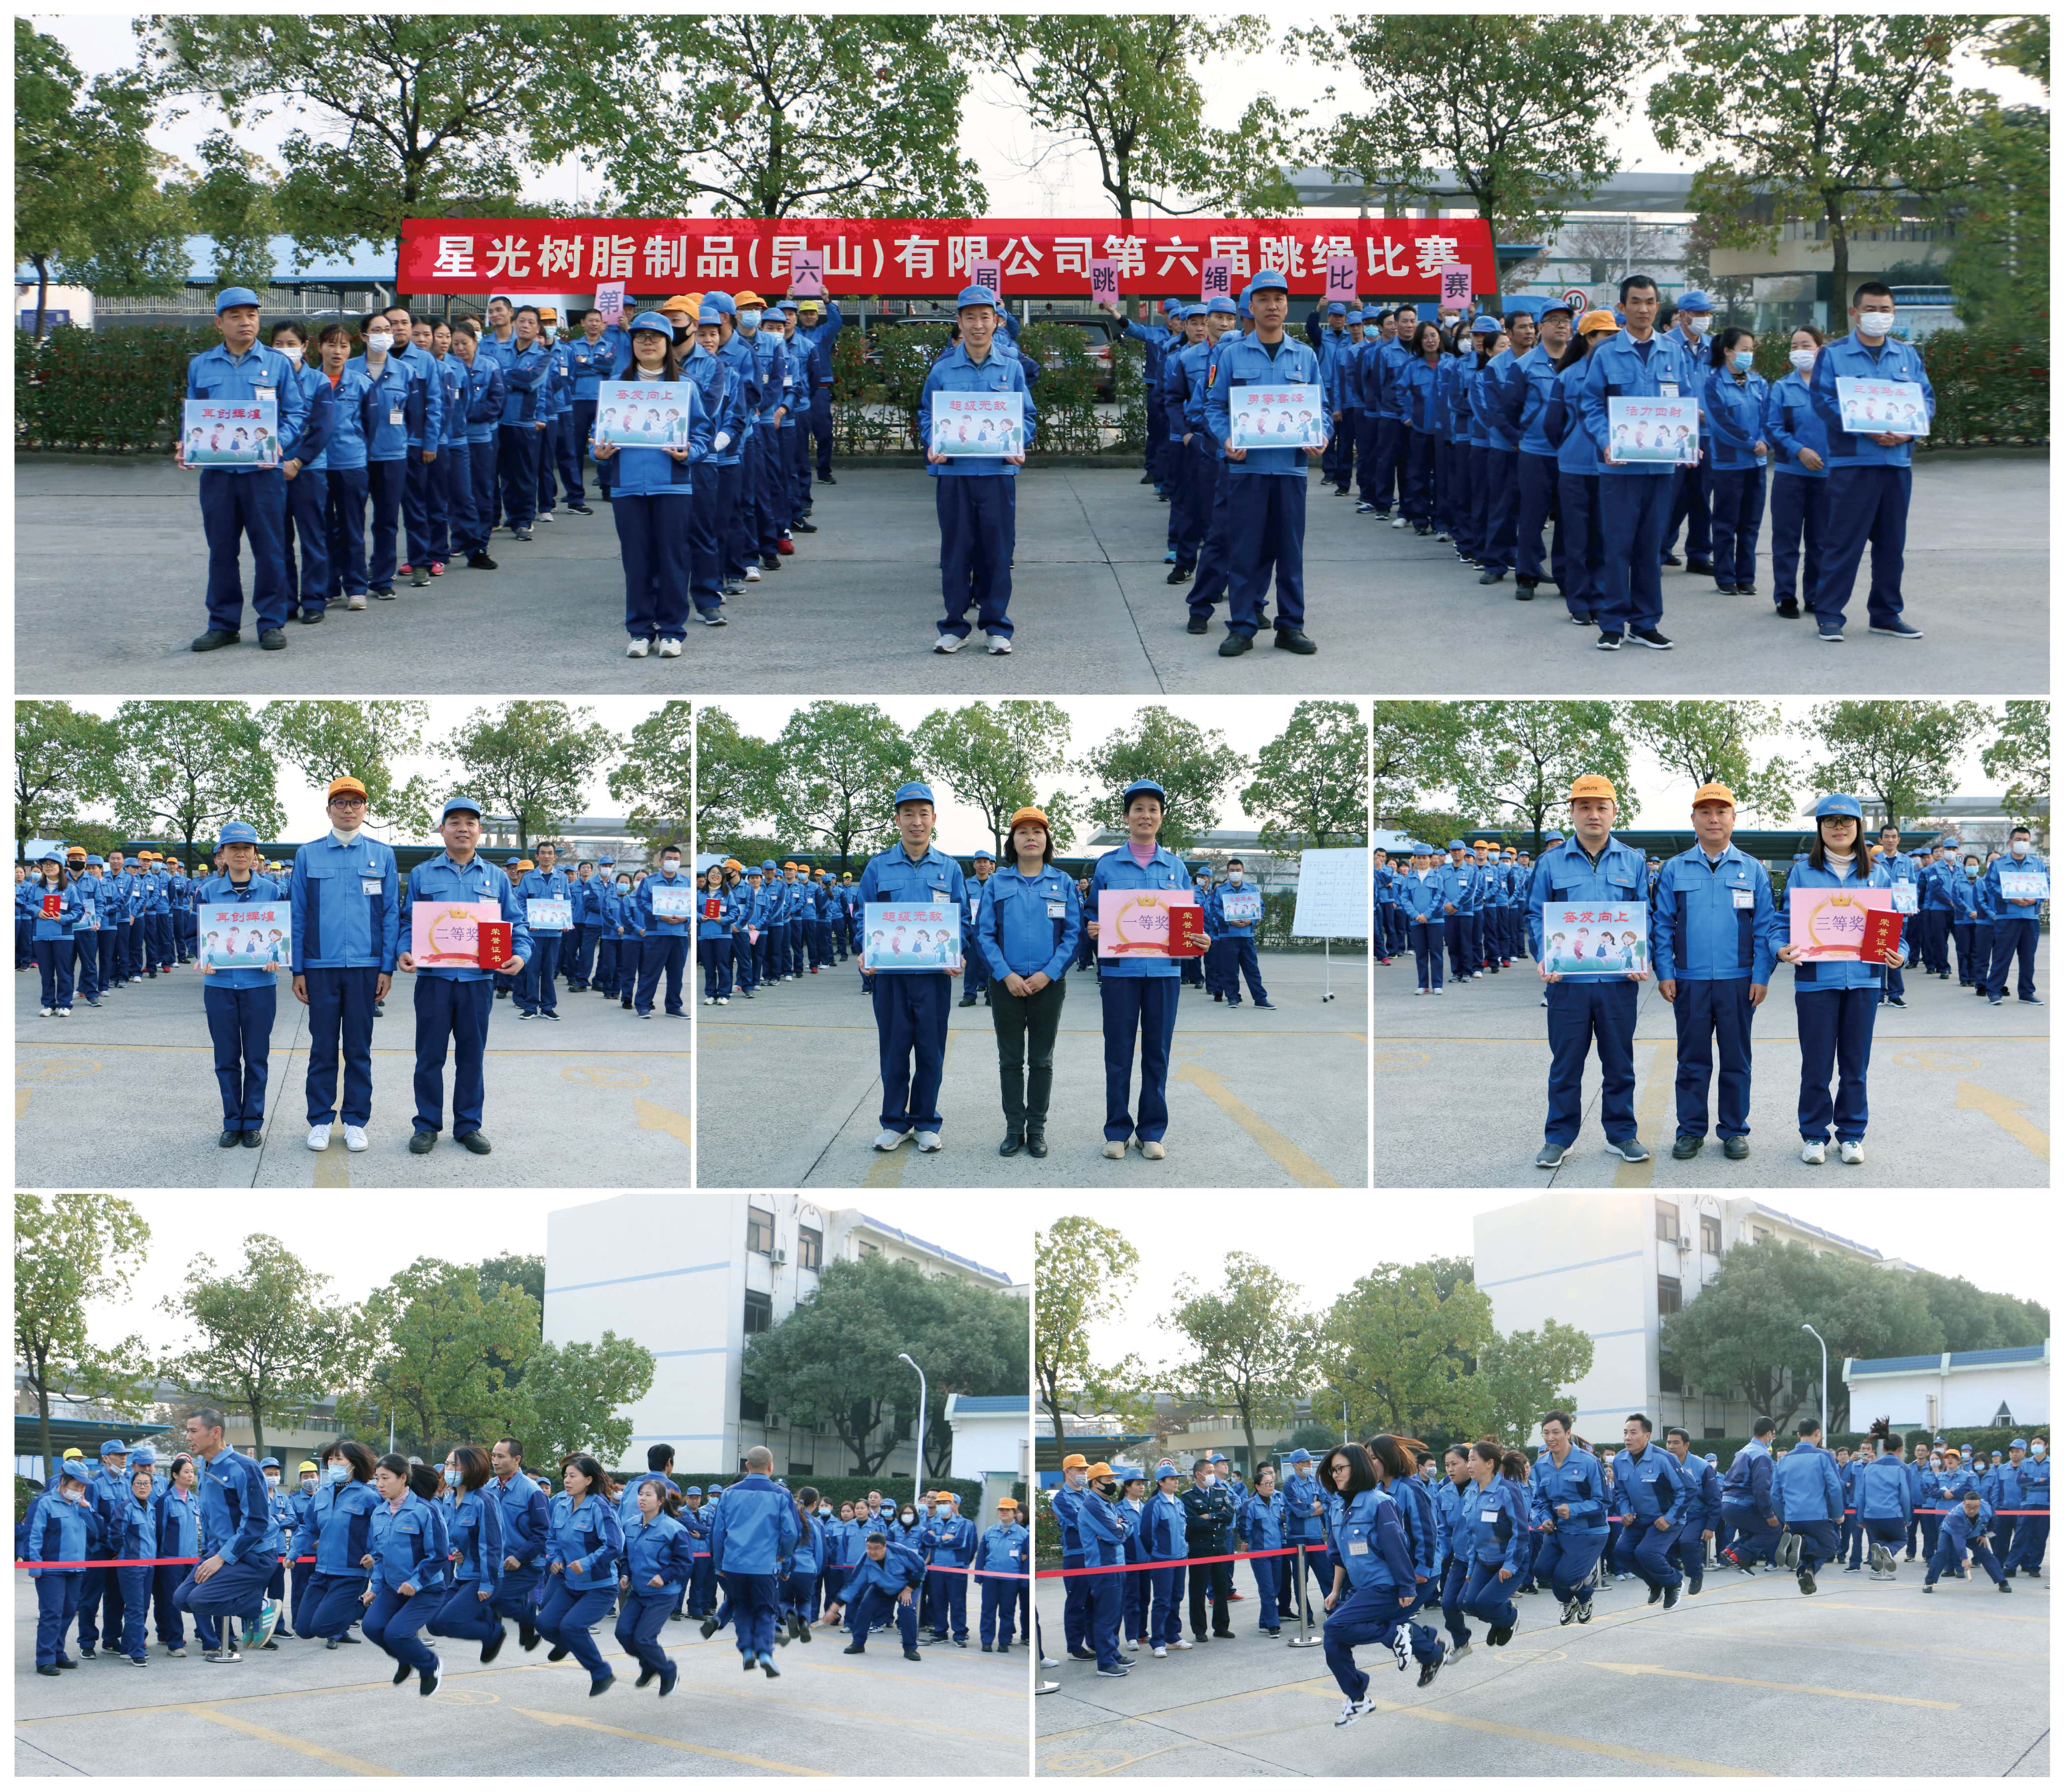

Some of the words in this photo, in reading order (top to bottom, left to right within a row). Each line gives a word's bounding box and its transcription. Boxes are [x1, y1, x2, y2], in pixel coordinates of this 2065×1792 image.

[796, 259, 820, 284] 六
[1093, 267, 1115, 291] 跳
[1205, 267, 1228, 291] 绳
[1330, 265, 1354, 289] 比
[1445, 272, 1469, 298] 赛
[599, 290, 621, 315] 第
[616, 389, 674, 400] 奋发向上
[1247, 393, 1305, 405] 勇攀高峰
[949, 400, 1007, 411] 超级无敌
[1626, 406, 1682, 417] 活力四射
[201, 408, 261, 419] 再创辉煌
[216, 911, 276, 923] 再创辉煌
[882, 911, 943, 922] 超级无敌
[1123, 915, 1169, 930] 一等奖
[1562, 911, 1629, 923] 奋发向上
[1815, 915, 1865, 931] 三等奖
[435, 927, 479, 941] 二等奖
[1182, 912, 1193, 948] 荣誉证书
[1874, 919, 1890, 956] 荣誉证书
[490, 928, 501, 962] 荣誉证书
